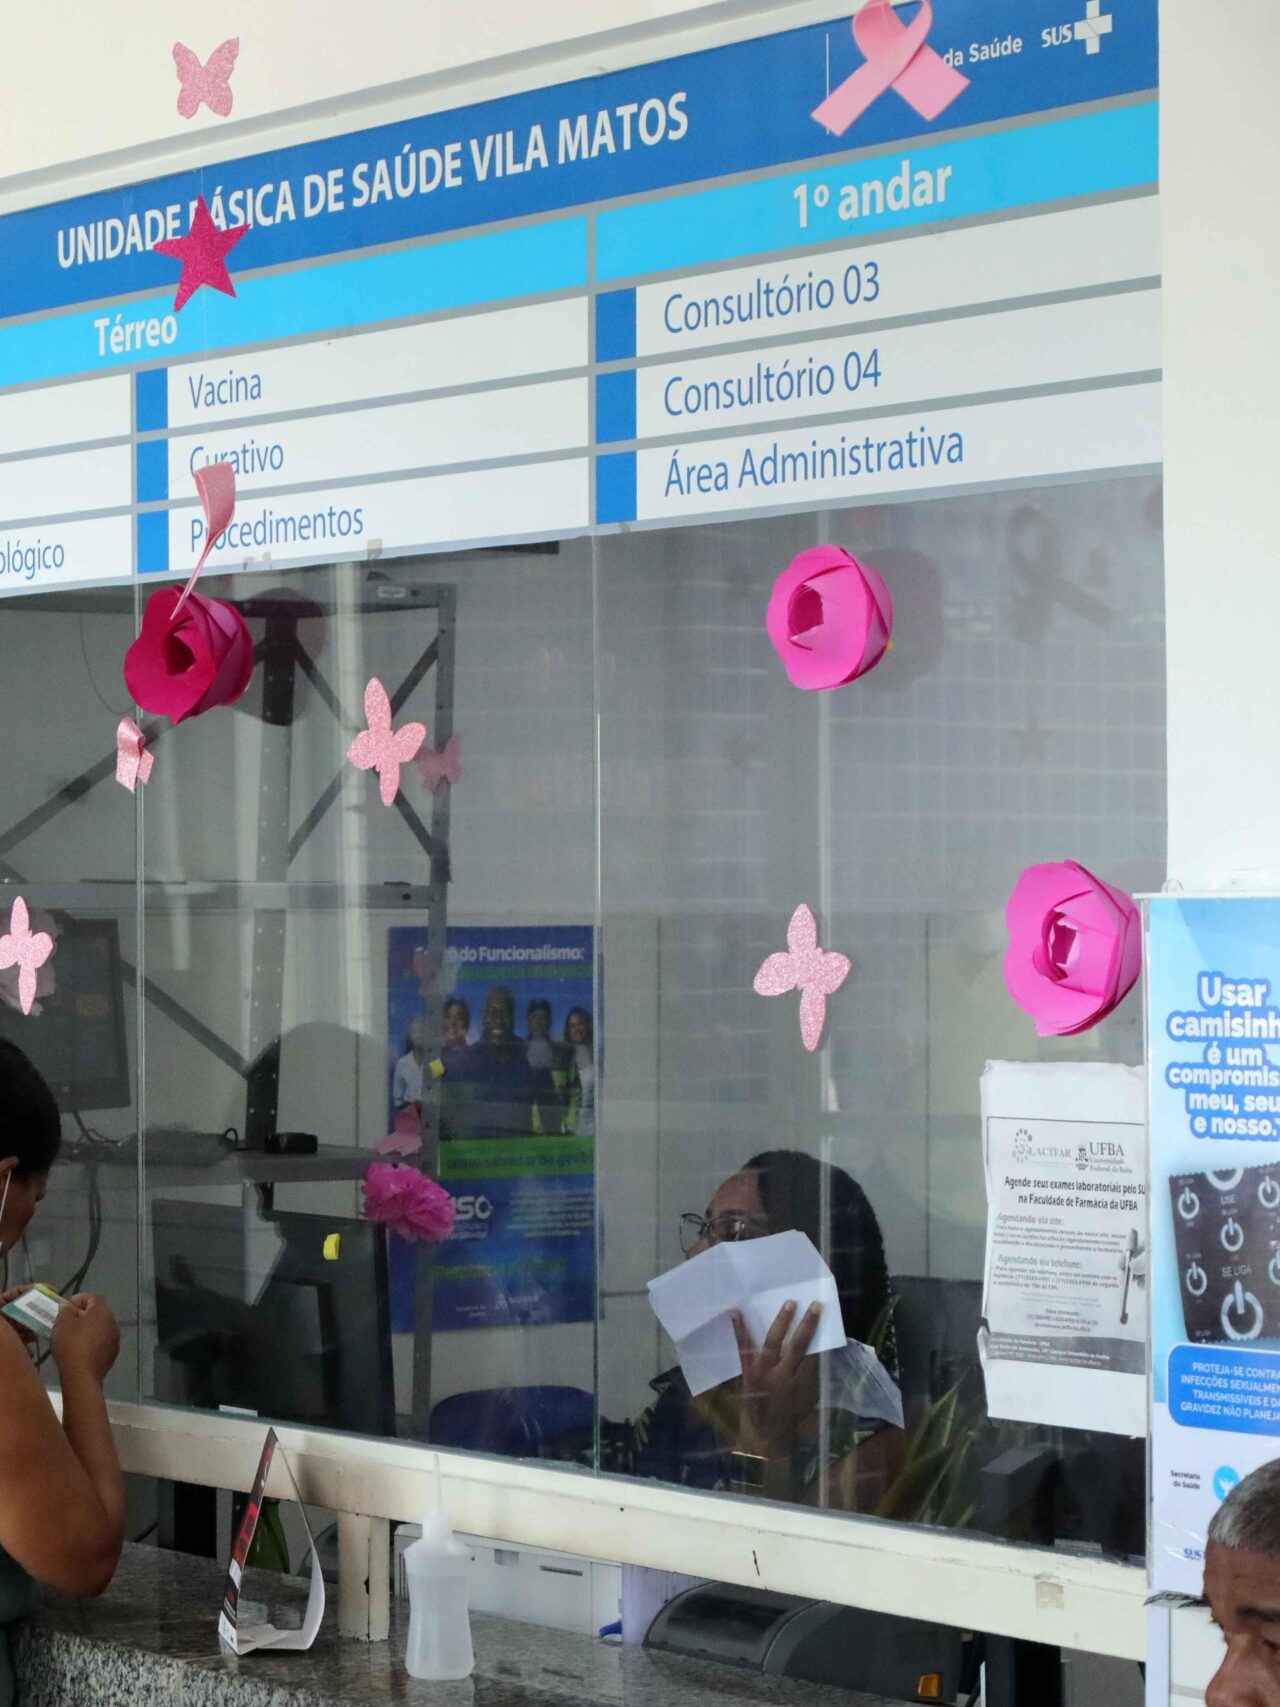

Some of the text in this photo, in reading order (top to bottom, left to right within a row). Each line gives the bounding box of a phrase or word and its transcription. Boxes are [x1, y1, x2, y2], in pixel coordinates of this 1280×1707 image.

[1040, 23, 1073, 49] SUS
[968, 35, 1023, 63] Saúde
[56, 202, 182, 269] UNIDADE
[303, 169, 345, 218] DE
[351, 143, 463, 208] SAÚDE
[470, 124, 549, 182] VILA
[558, 91, 689, 165] MATOS
[838, 159, 953, 222] andar
[664, 261, 881, 334] Consultório 03
[94, 313, 178, 356] Térreo
[189, 369, 262, 409] Vacina
[664, 348, 882, 417] Consultório 04
[664, 426, 964, 498] Área Administrativa
[191, 505, 364, 553] Pocedimentos
[460, 946, 477, 961] do
[479, 945, 585, 961] Funcionalismo:
[1201, 976, 1268, 1008] Usar
[1207, 1041, 1263, 1067] é um
[1189, 1092, 1240, 1115] meu,
[1193, 1116, 1207, 1133] e
[1089, 1142, 1125, 1157] UFBA
[1004, 1176, 1031, 1189] Agende
[1033, 1178, 1049, 1189] seus
[1050, 1180, 1075, 1190] exames
[1076, 1181, 1122, 1193] laboratoriais
[1122, 1183, 1137, 1196] pelo
[1018, 1195, 1028, 1204] na
[1029, 1194, 1065, 1207] Faculdade
[1065, 1196, 1074, 1207] de
[1109, 1199, 1119, 1210] da
[1120, 1200, 1138, 1211] UFBA
[1222, 1266, 1233, 1278] SE
[1181, 1373, 1229, 1389] INFECÇÕES
[1192, 1361, 1245, 1378] PROTEJA-SE
[1192, 1388, 1262, 1407] TRANSMISSÍVEIS
[1263, 1396, 1270, 1407] E
[1180, 1401, 1222, 1416] GRAVIDEZ
[1223, 1403, 1242, 1418] NÃO
[1170, 1470, 1201, 1491] Secretaria da Saúde
[1183, 1547, 1202, 1561] SUS
